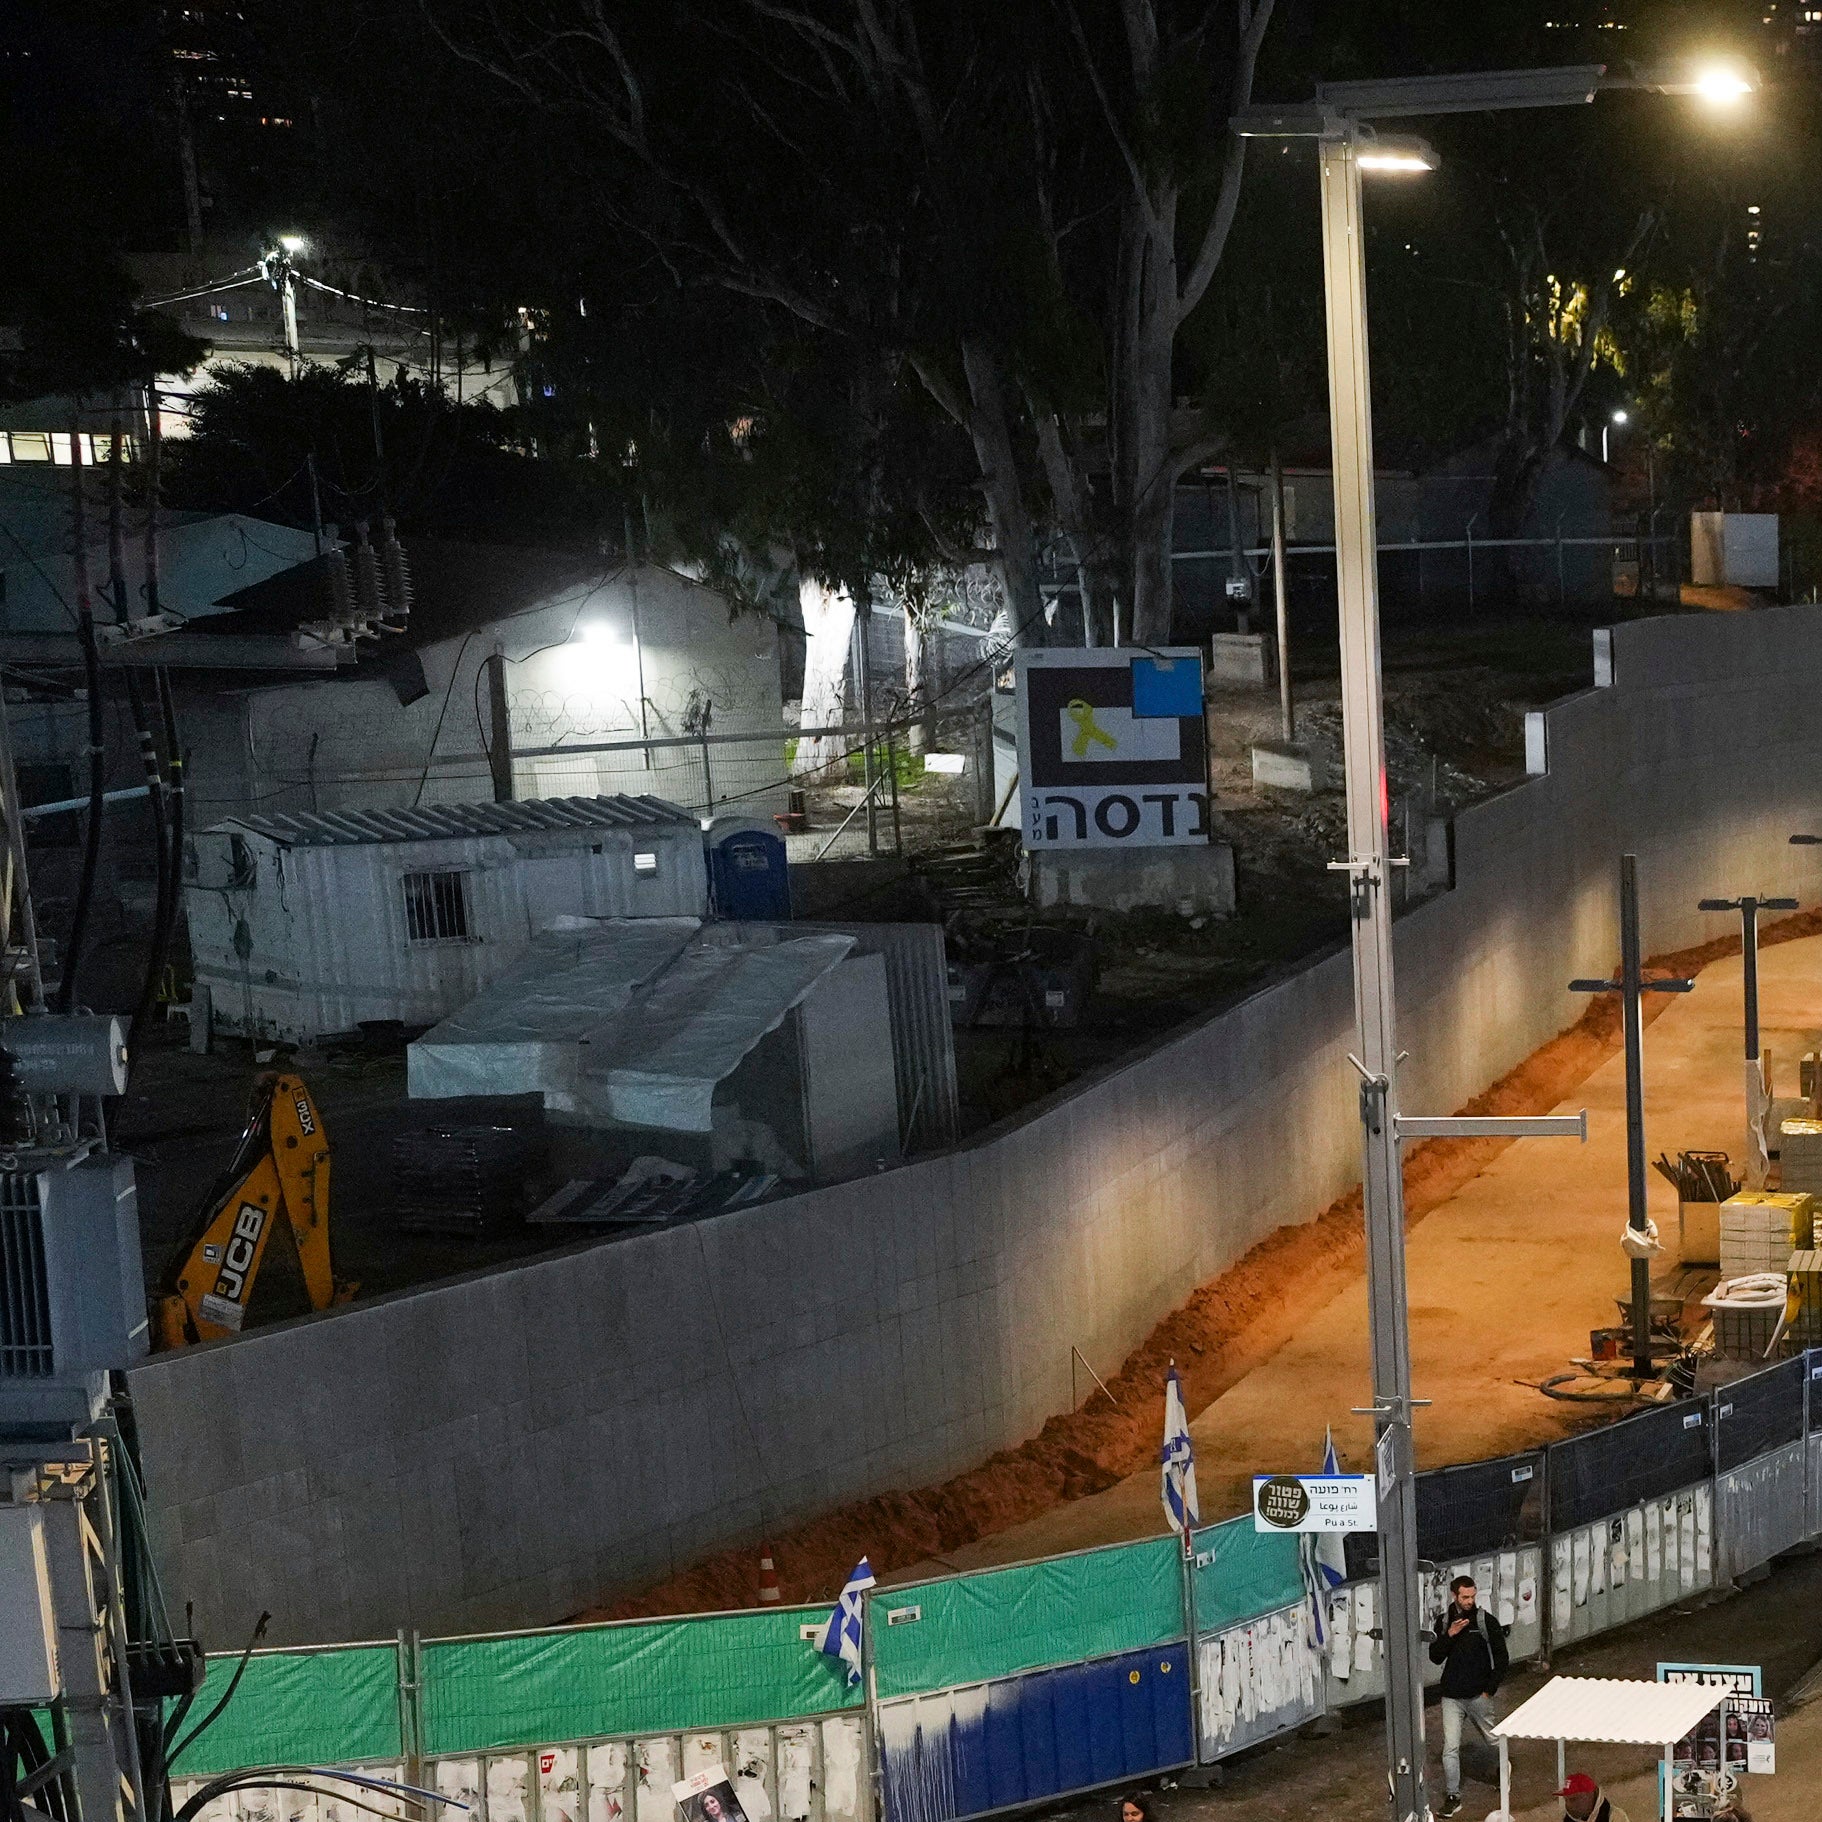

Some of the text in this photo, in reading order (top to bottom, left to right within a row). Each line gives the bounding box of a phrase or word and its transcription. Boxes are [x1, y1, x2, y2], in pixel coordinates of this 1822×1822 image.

[221, 1206, 265, 1299] JCB
[1268, 1484, 1302, 1499] פטור
[1310, 1486, 1339, 1494] פועה
[1267, 1496, 1301, 1509] שווה
[1340, 1502, 1358, 1512] شارع
[1266, 1506, 1300, 1520] לכולם!
[1348, 1519, 1358, 1527] St.
